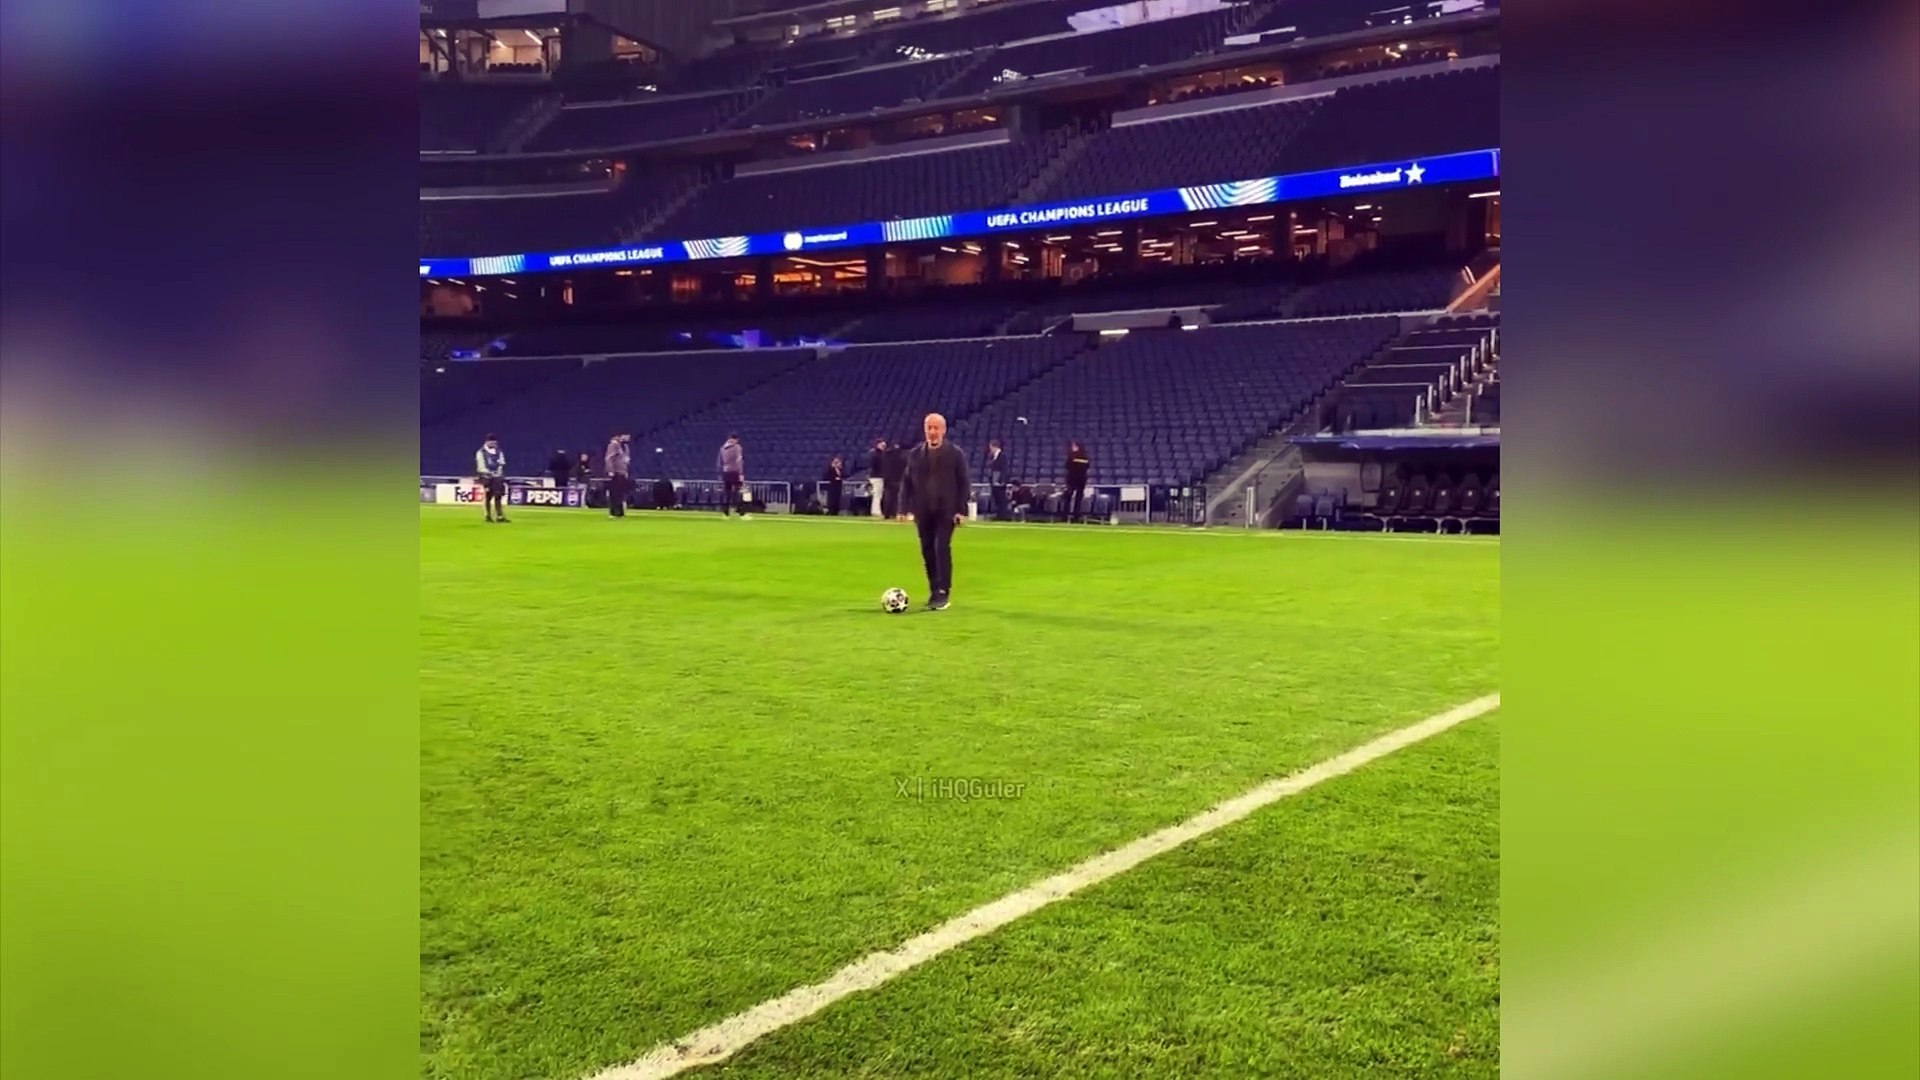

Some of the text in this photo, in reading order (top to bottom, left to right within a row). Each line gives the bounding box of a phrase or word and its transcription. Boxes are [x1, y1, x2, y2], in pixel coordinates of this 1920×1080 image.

[987, 198, 1149, 227] UEFA CHAMPIONS LEAGUE
[549, 247, 663, 266] UEFA CHAMPIONS LEAGUE
[526, 490, 563, 505] PEPSI
